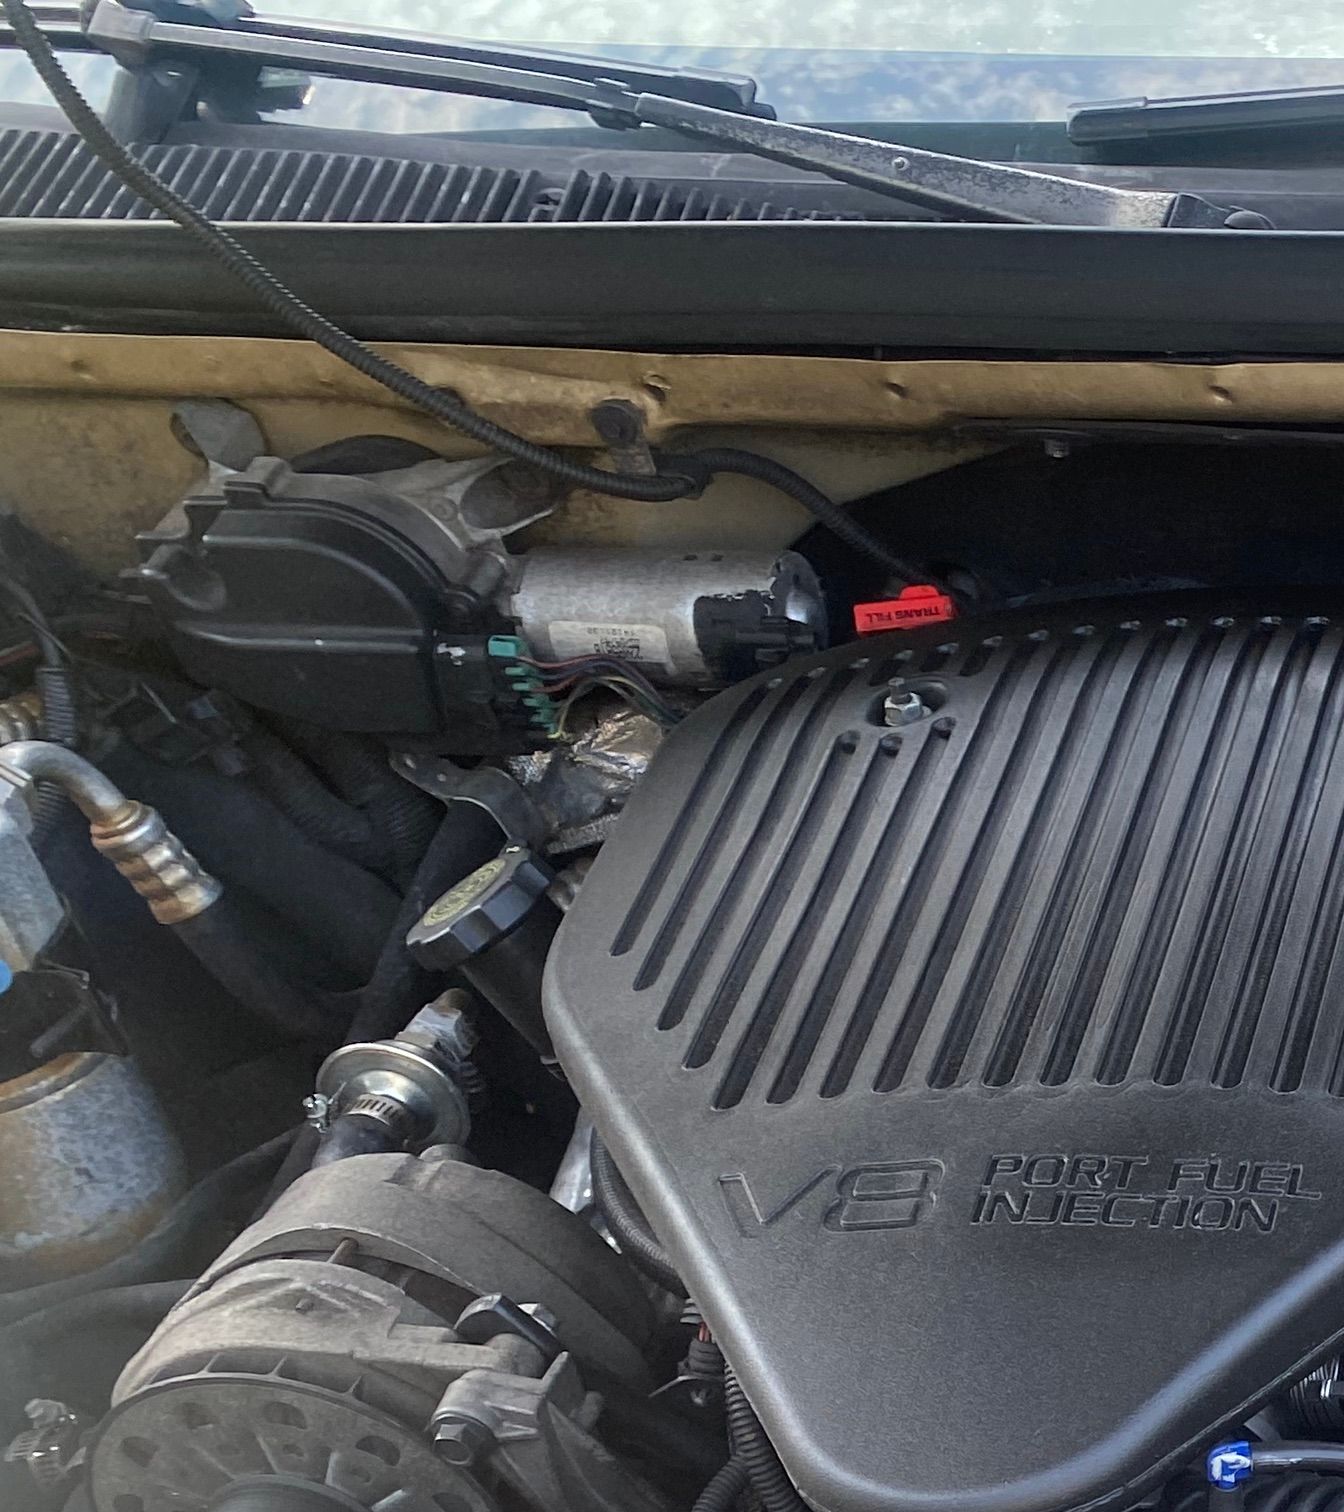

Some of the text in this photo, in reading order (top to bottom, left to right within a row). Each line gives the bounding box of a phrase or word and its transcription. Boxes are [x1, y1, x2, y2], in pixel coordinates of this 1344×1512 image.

[865, 606, 940, 623] TRANS FILL
[717, 1157, 946, 1238] V8
[982, 1153, 1322, 1200] PORT FUEL
[970, 1189, 1280, 1233] INJECTION
